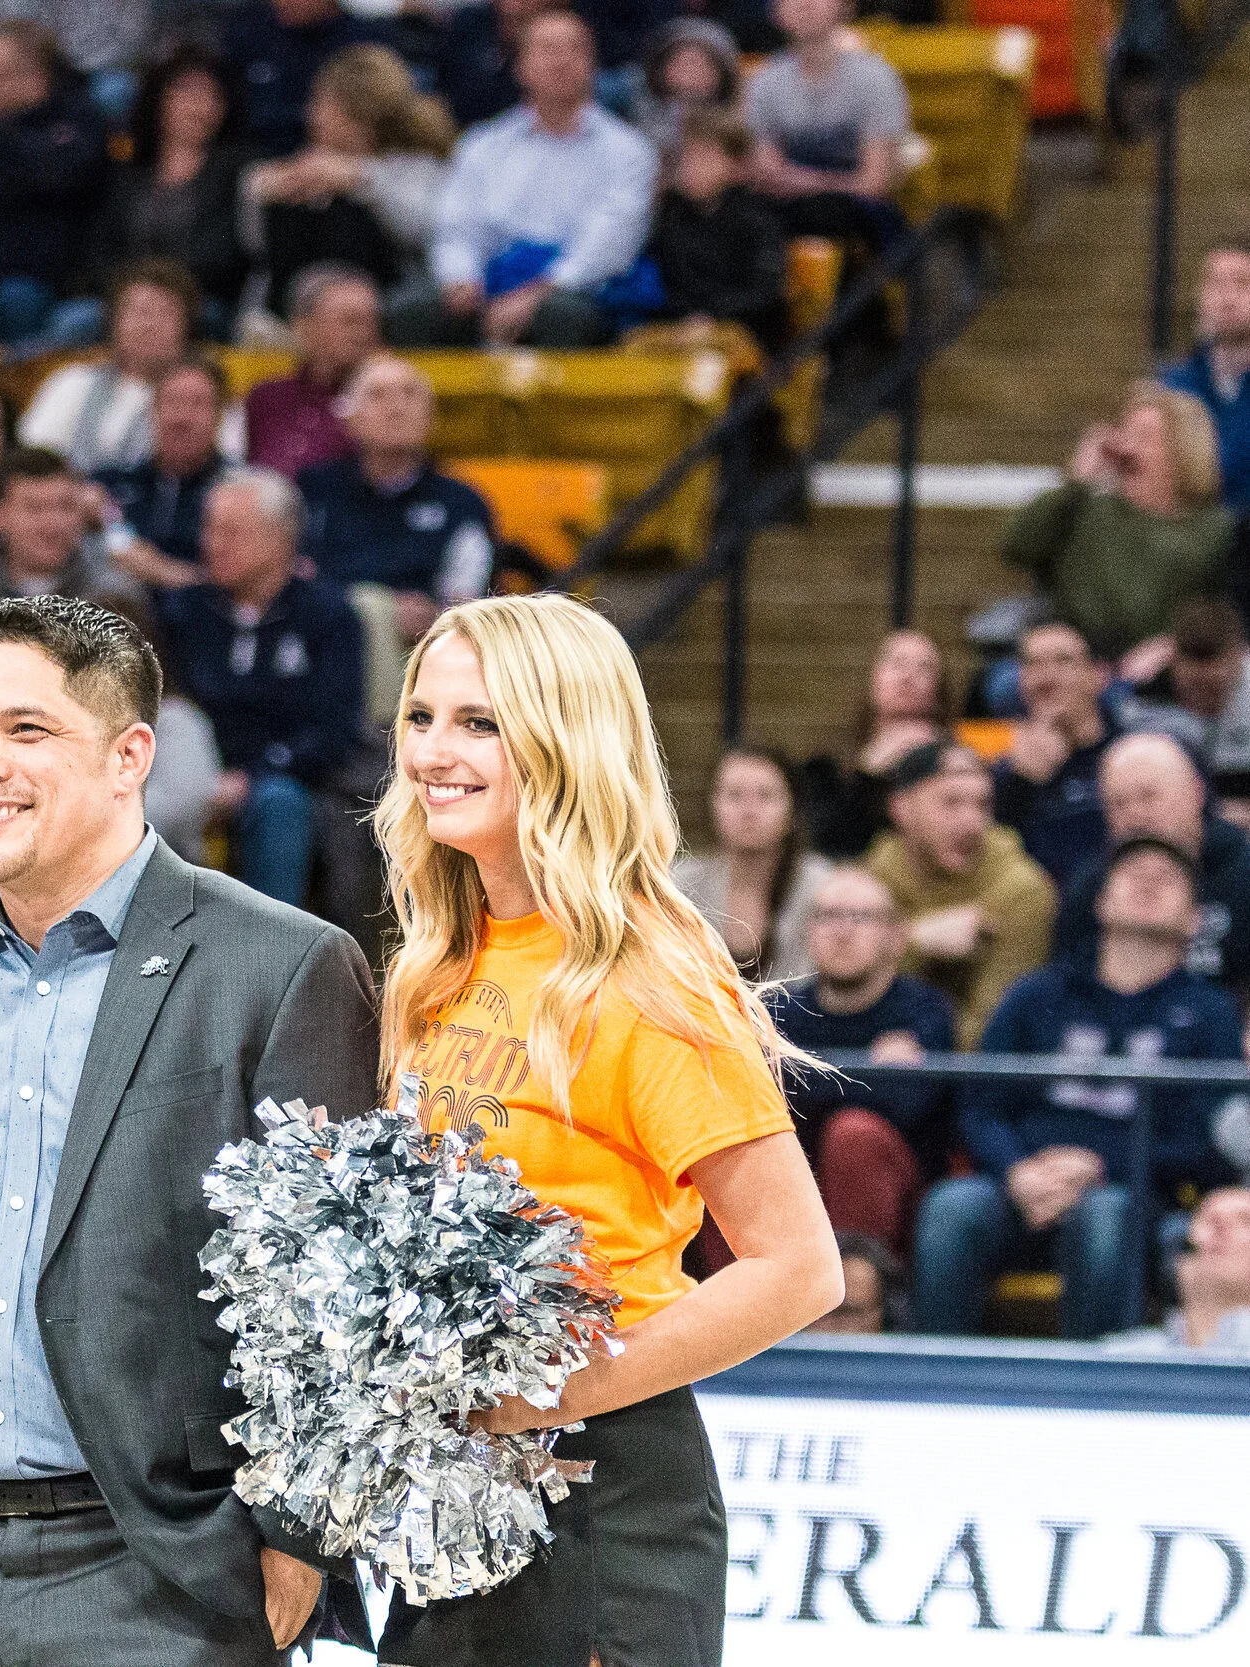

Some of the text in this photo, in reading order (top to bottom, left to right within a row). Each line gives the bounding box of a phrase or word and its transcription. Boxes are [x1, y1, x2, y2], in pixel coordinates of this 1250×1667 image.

[475, 987, 505, 1024] STATE
[723, 1429, 861, 1484] THE
[724, 1506, 1248, 1639] ERALD
